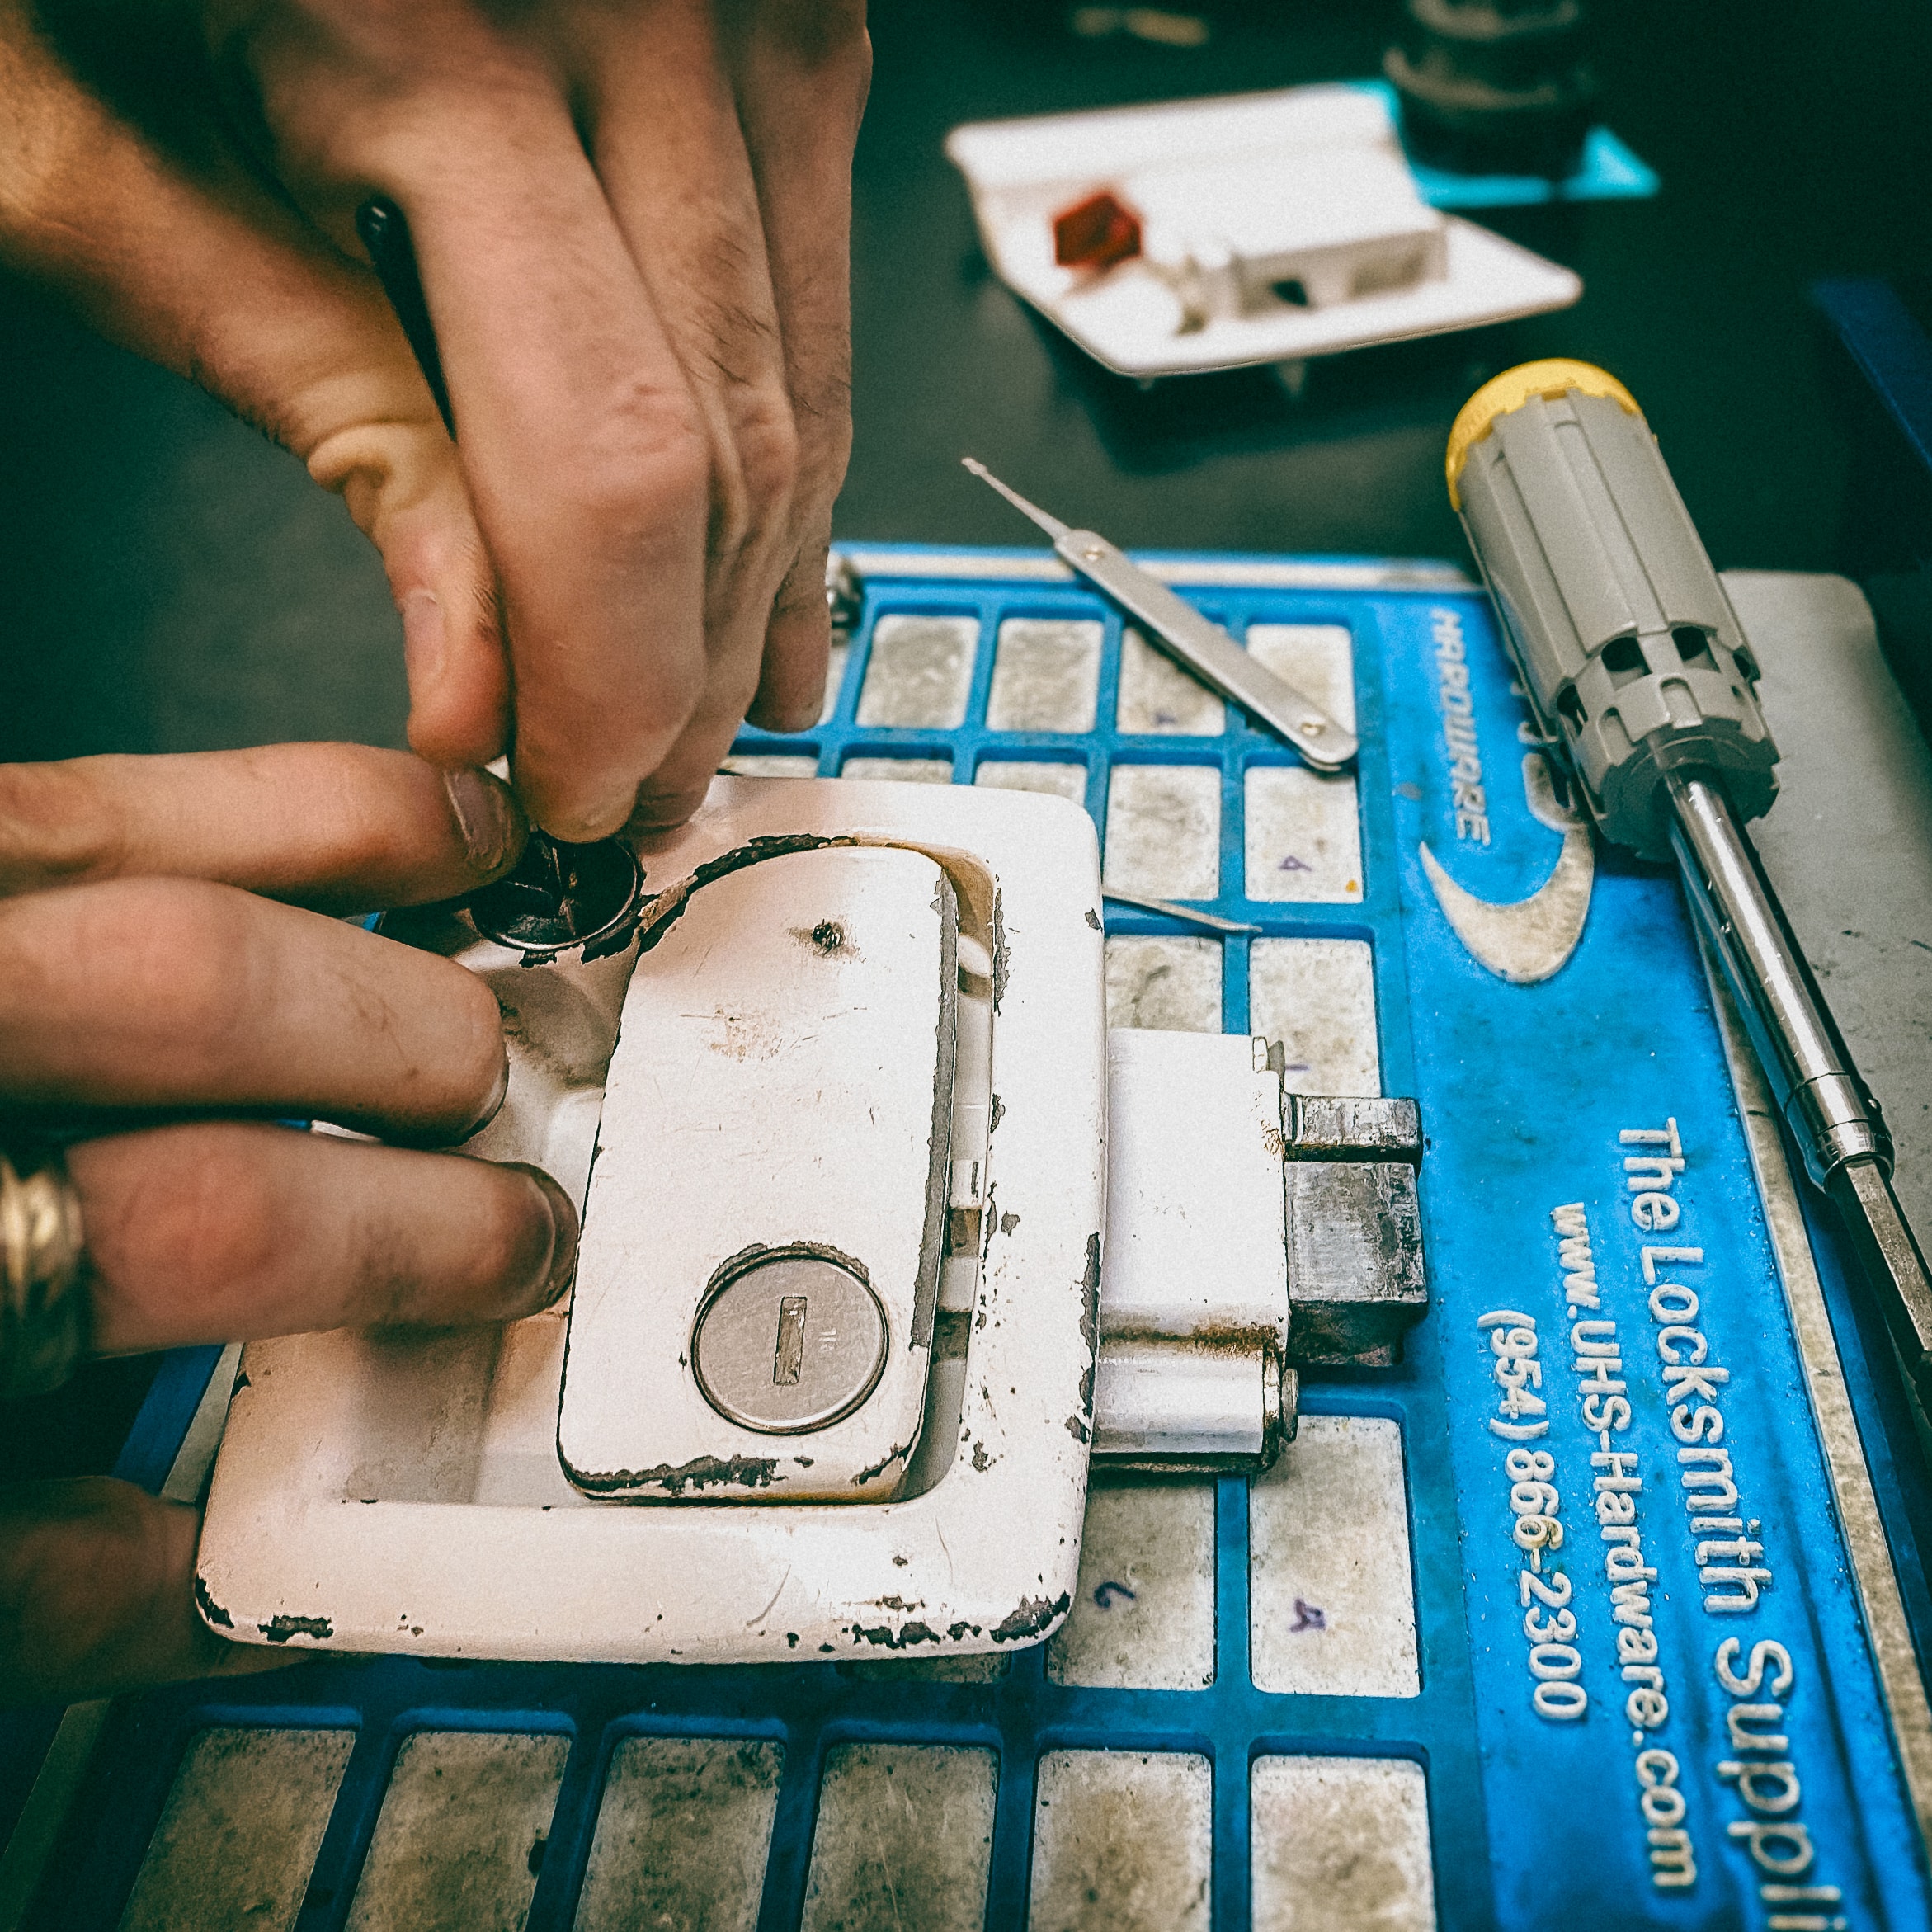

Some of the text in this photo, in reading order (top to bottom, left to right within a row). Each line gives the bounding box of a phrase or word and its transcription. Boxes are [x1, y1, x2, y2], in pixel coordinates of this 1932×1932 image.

[1430, 608, 1491, 846] HARDWARE
[1619, 1117, 1685, 1230] The
[1551, 1202, 1696, 1887] www.UHS-Hardware.com
[1641, 1246, 1772, 1612] Locksmith
